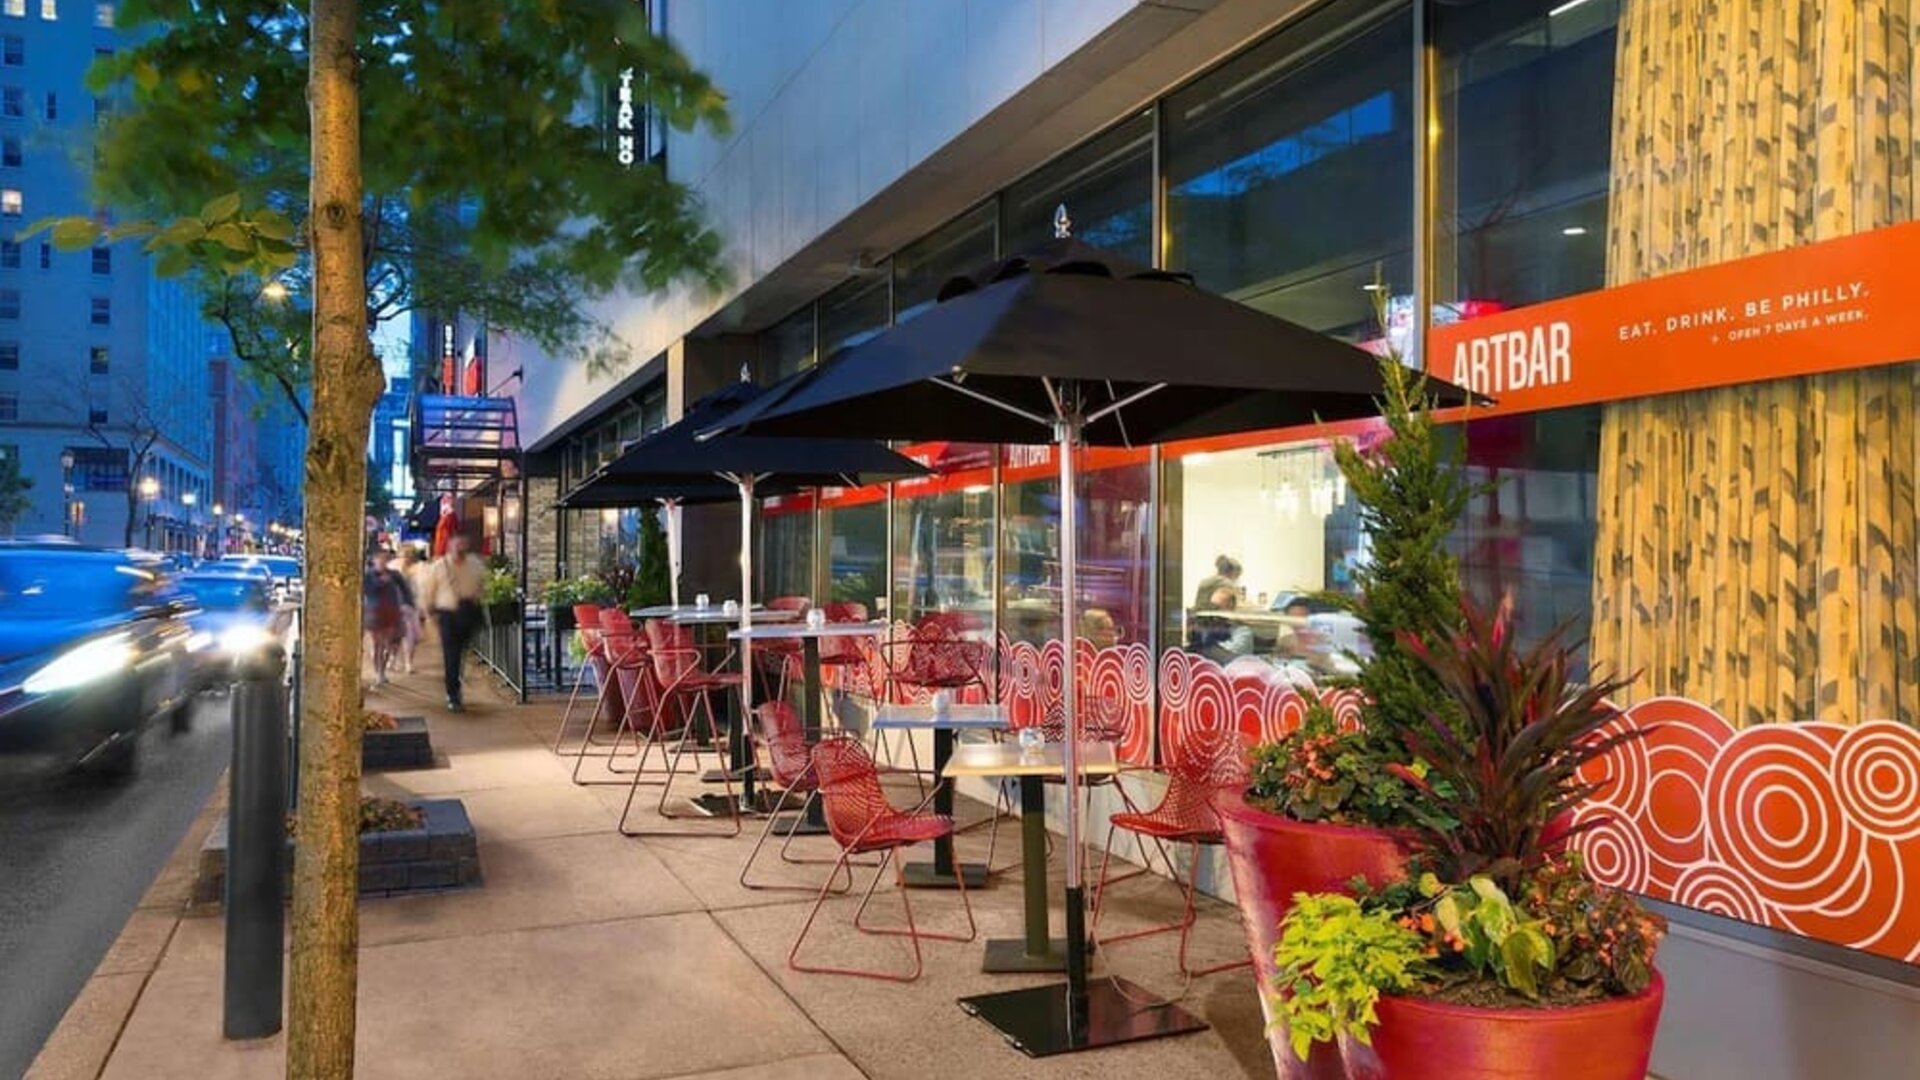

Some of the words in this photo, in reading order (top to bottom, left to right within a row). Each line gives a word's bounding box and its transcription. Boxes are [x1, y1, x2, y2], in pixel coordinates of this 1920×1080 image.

[1619, 321, 1658, 341] EAT.
[1666, 307, 1735, 332] DRINK.
[1744, 298, 1771, 317] BE
[1782, 282, 1870, 311] PHILLY.
[1728, 326, 1762, 341] OPEN
[1765, 324, 1772, 335] 7
[1776, 319, 1807, 333] DAYS
[1812, 316, 1820, 326] A
[1826, 310, 1869, 325] WEEK.
[1453, 321, 1571, 395] ARTBAR
